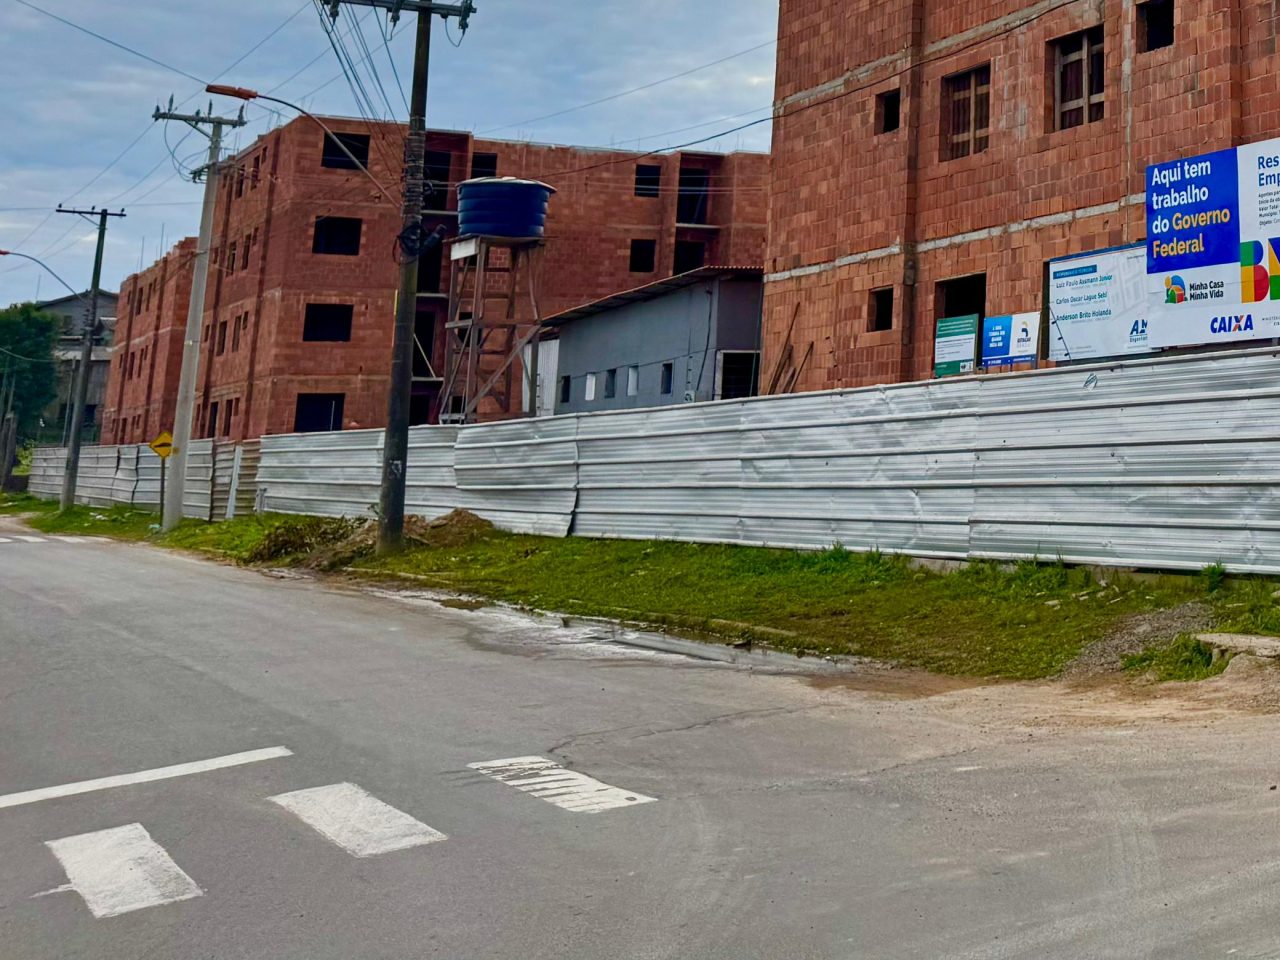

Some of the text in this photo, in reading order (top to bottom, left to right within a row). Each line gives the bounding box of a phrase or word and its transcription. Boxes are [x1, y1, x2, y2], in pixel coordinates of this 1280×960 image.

[1151, 160, 1211, 188] Aqui tem
[1151, 183, 1209, 210] trabalho
[1152, 208, 1231, 234] do Governo
[1152, 233, 1205, 259] Federal
[1189, 280, 1224, 291] Minha Casa
[1189, 289, 1224, 301] Minha Vida
[1056, 296, 1070, 305] Carlos
[1056, 312, 1078, 321] Anderson
[1210, 313, 1254, 334] CAIXA
